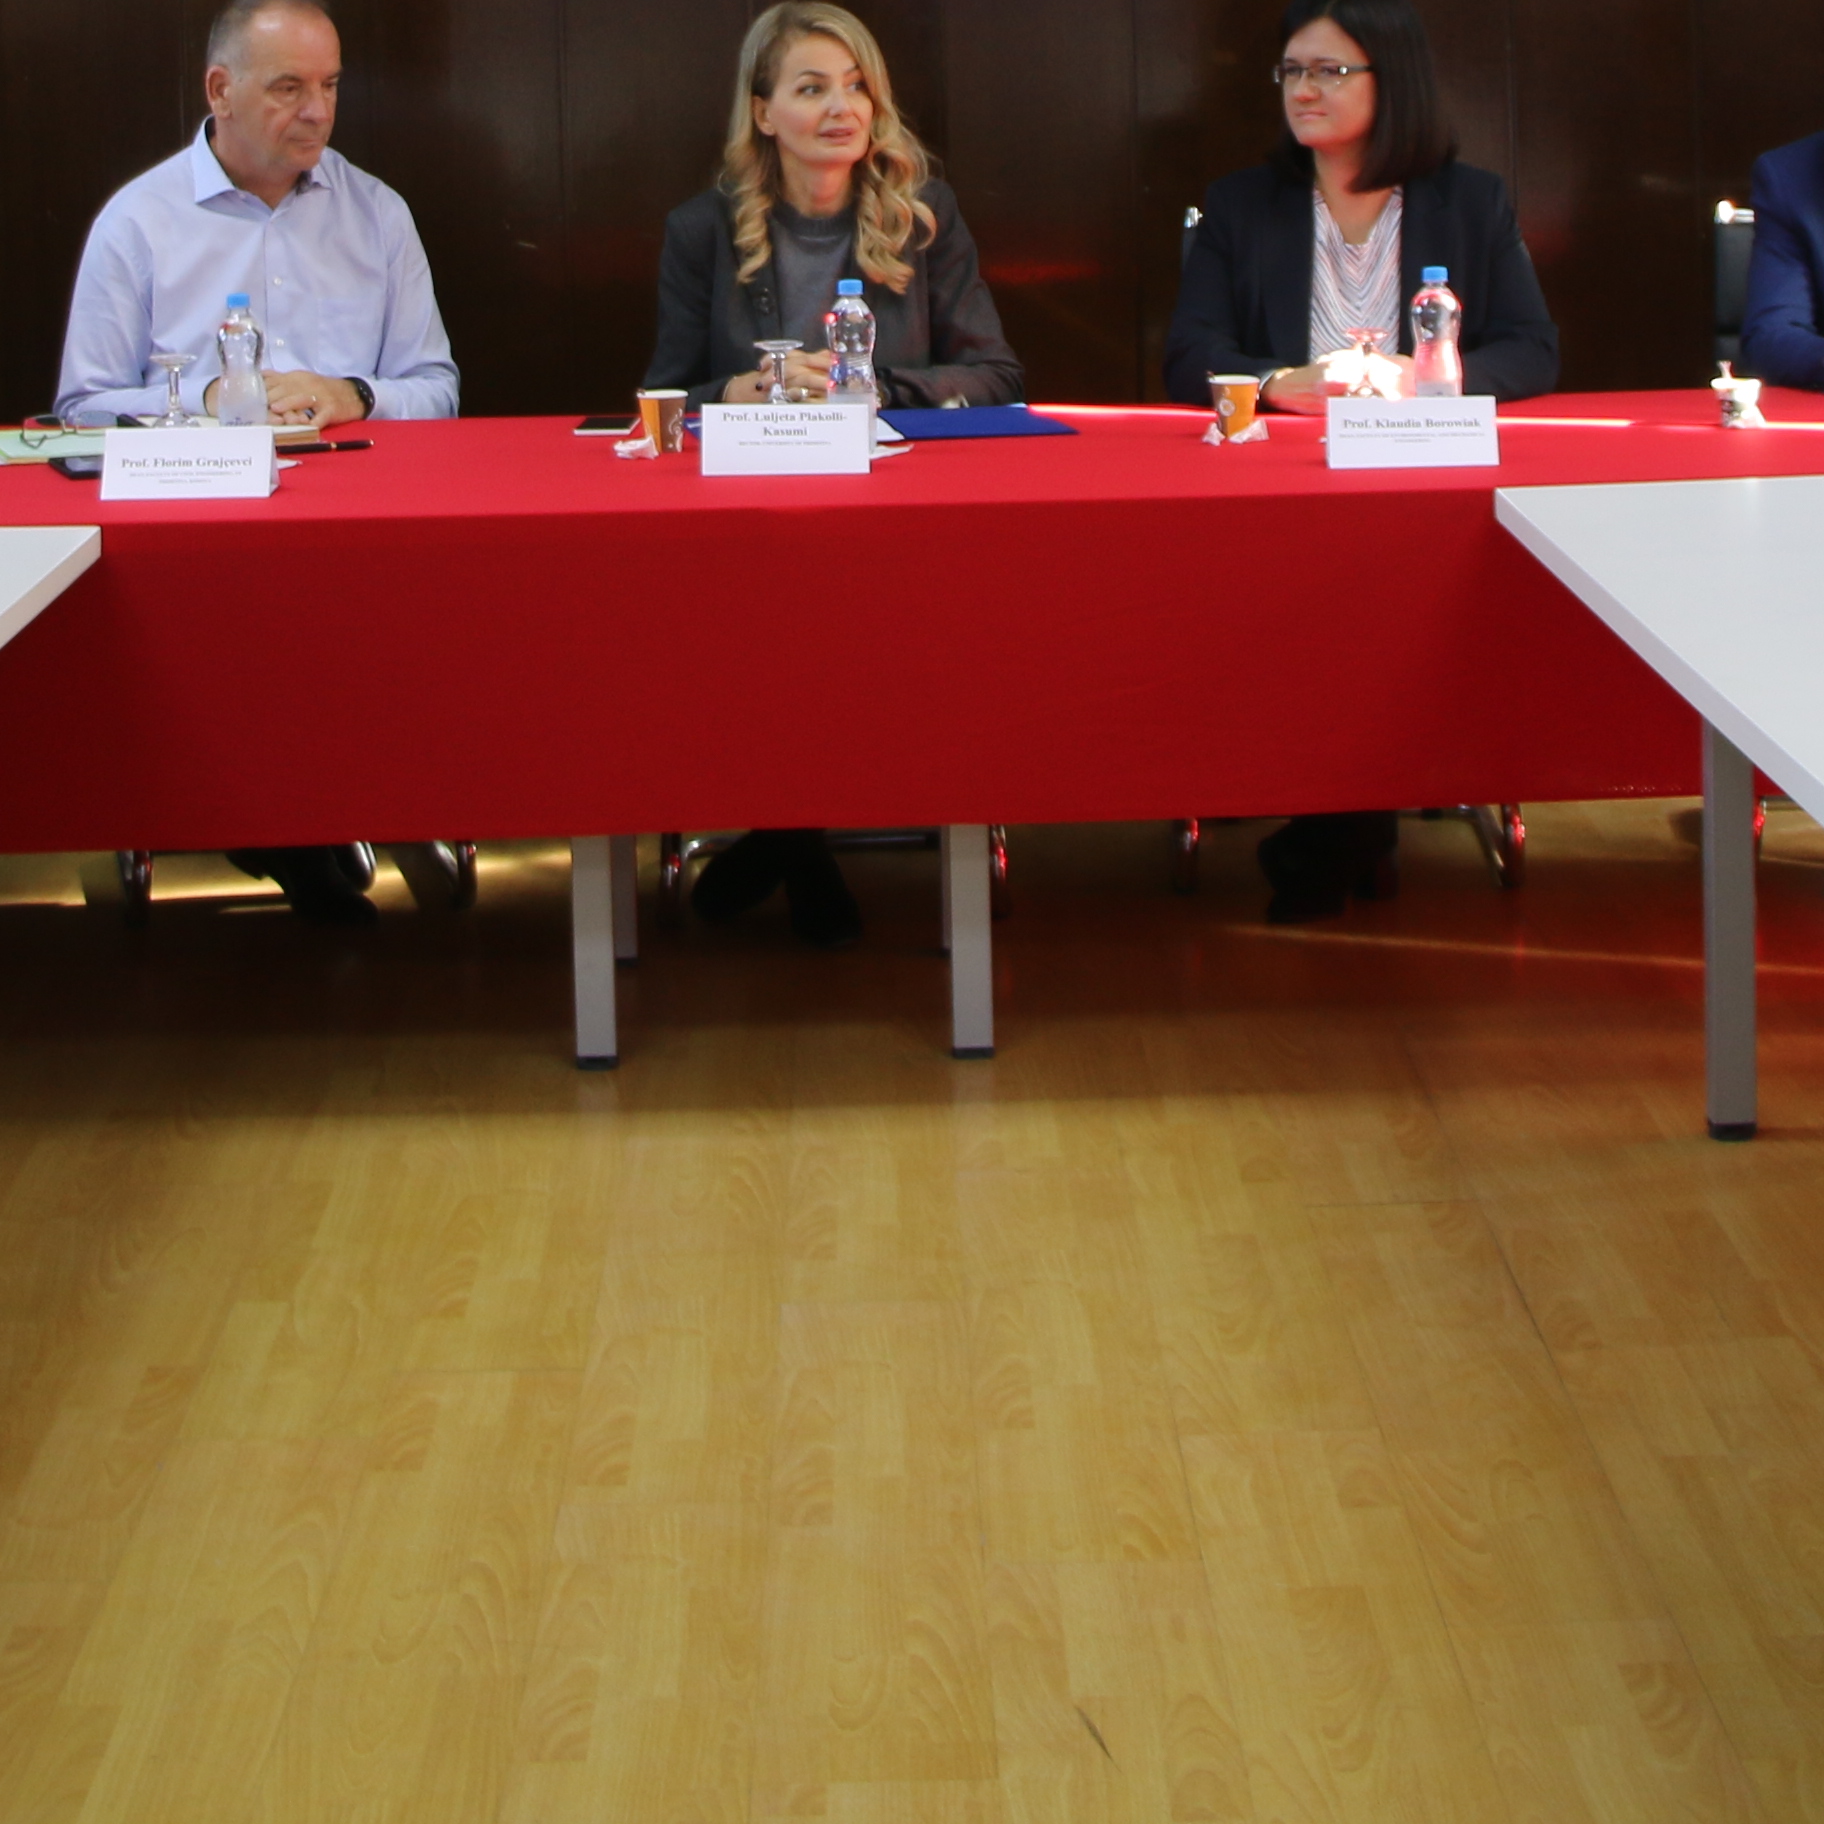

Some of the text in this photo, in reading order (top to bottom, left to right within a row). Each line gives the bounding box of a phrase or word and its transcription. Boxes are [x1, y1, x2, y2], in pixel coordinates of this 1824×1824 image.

[723, 412, 848, 424] Prof. Luljeta Plakolli-
[1343, 417, 1481, 429] Prof. Klaudia Borowiak
[763, 427, 808, 437] Kasumi
[121, 457, 150, 468] Prof.
[154, 457, 193, 468] Florim
